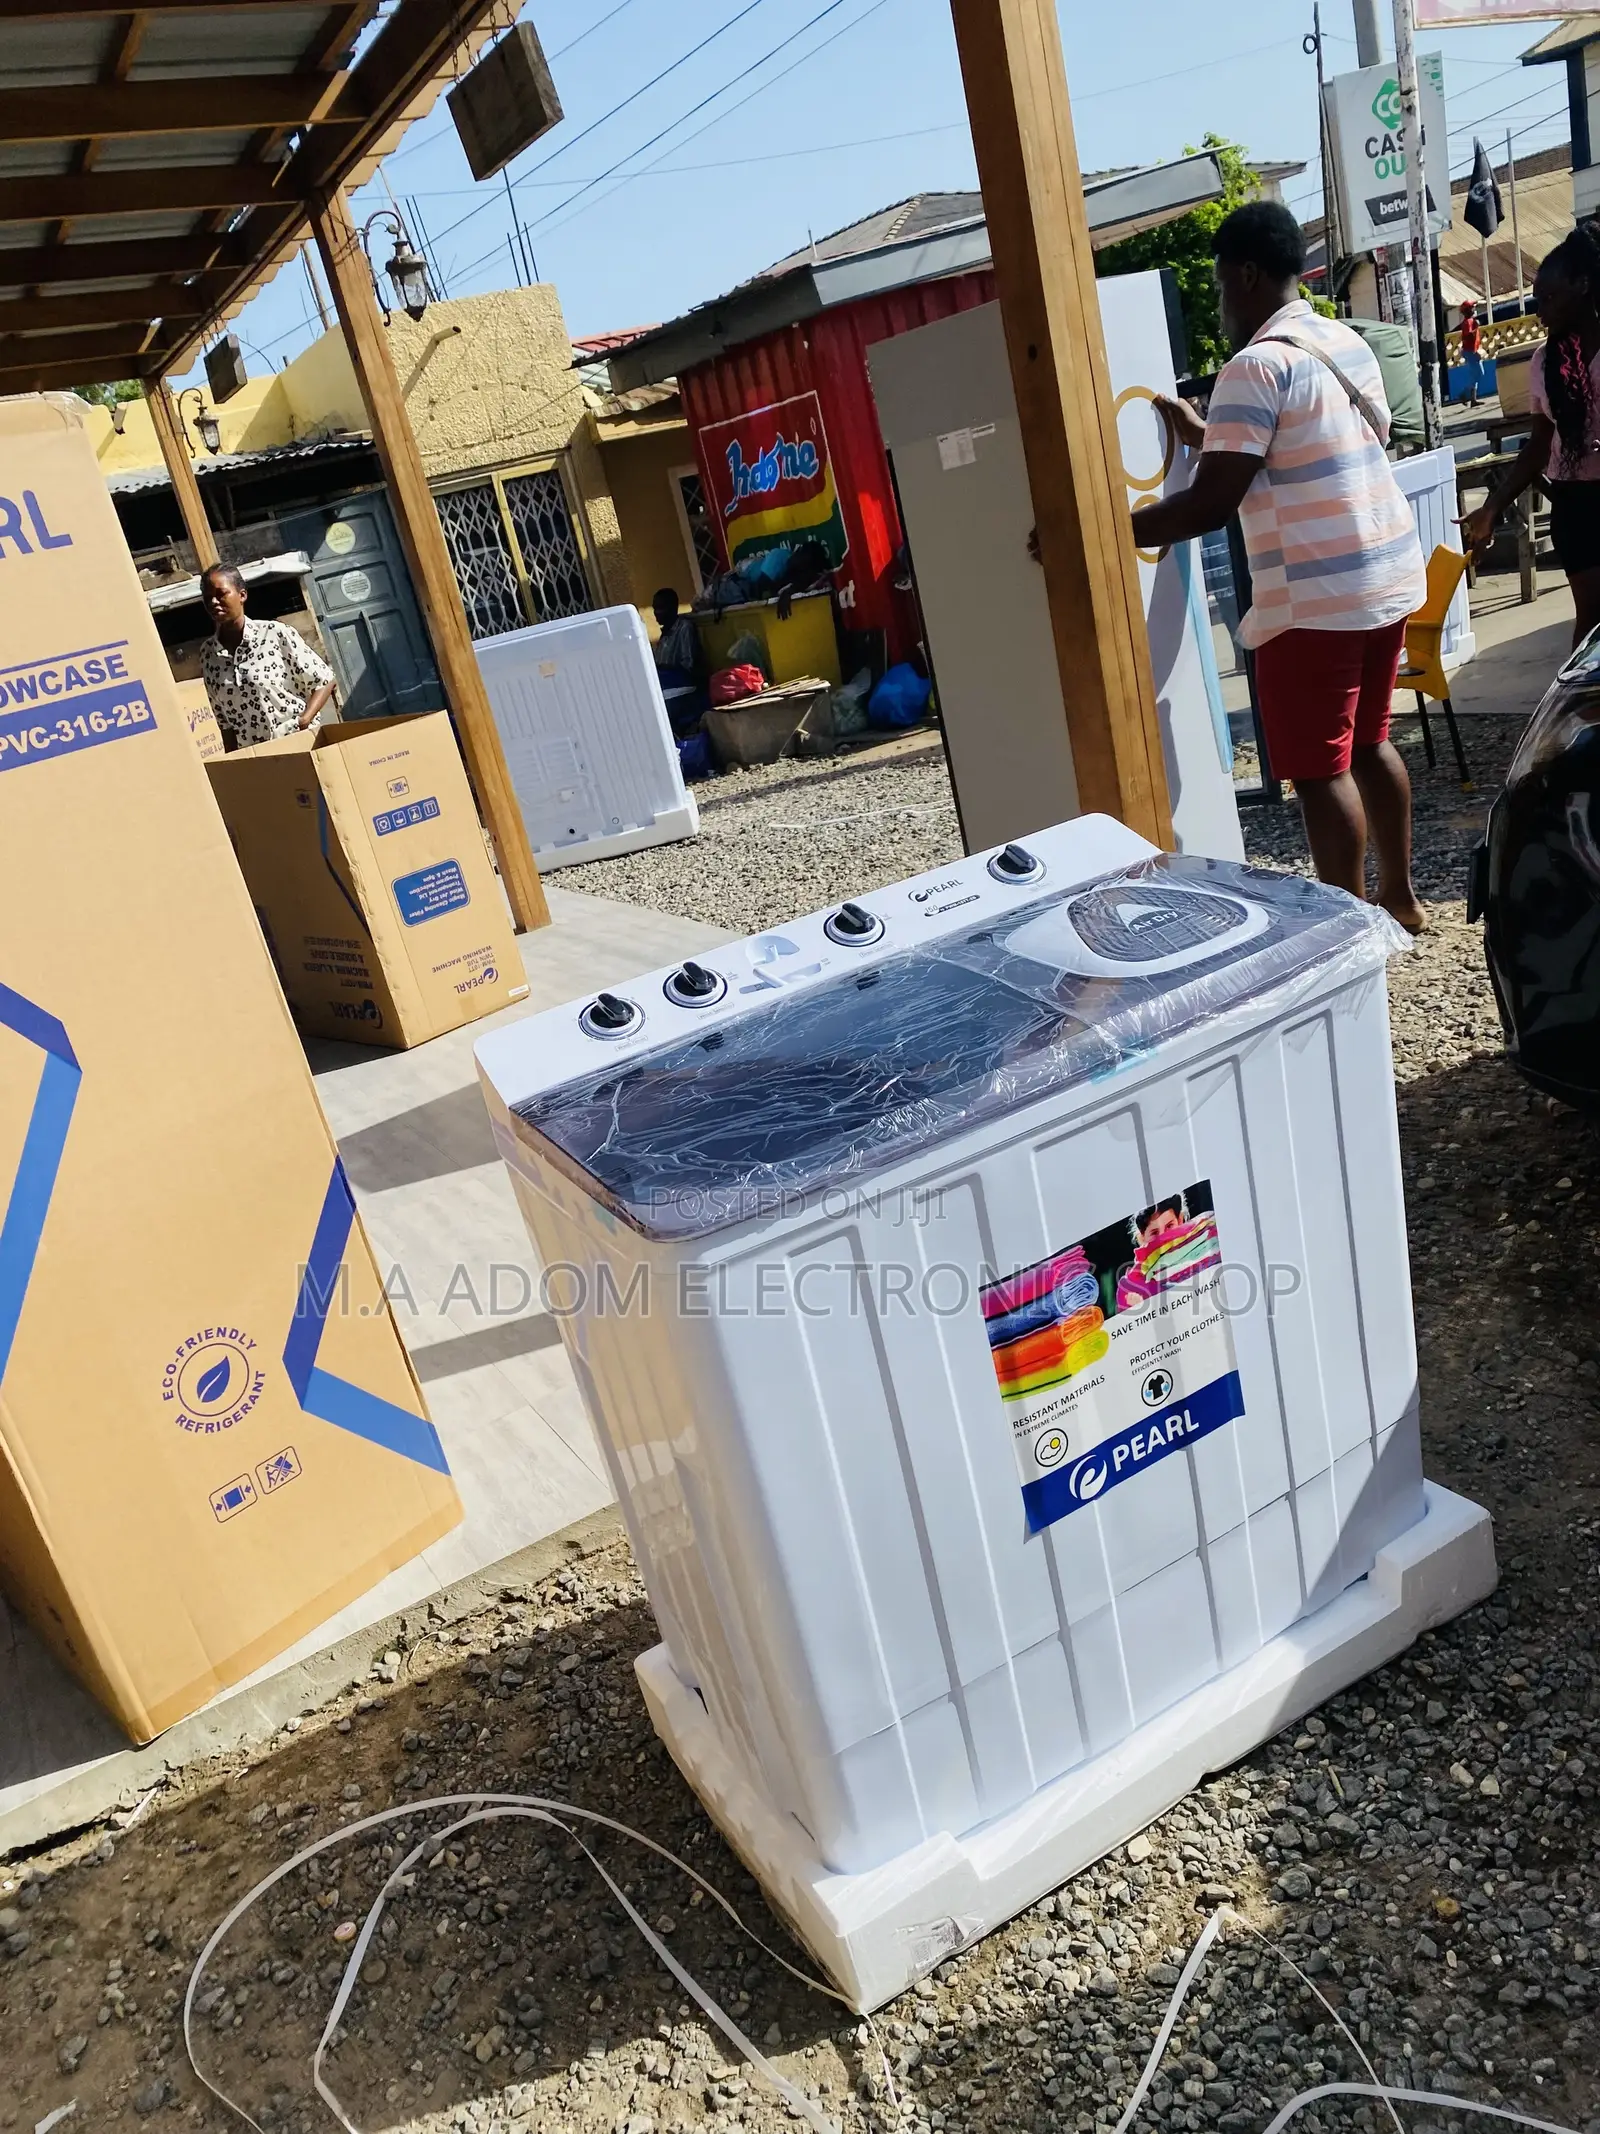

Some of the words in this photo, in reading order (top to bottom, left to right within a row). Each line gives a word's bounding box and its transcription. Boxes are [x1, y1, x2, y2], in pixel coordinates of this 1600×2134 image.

[1365, 124, 1426, 159] CAS
[1374, 154, 1408, 180] OU
[368, 757, 387, 767] CHINA
[925, 879, 964, 896] PEARL
[1132, 921, 1154, 931] Air
[1151, 911, 1179, 923] Dry
[431, 959, 462, 974] MACHINE
[461, 945, 493, 960] WASHING
[453, 974, 485, 994] PEARL
[1110, 1322, 1134, 1340] SAVE
[1134, 1309, 1157, 1327] TIME
[1158, 1305, 1169, 1316] IN
[1171, 1292, 1194, 1311] EACH
[1194, 1278, 1221, 1297] WASH
[1129, 1341, 1166, 1367] PROTECT
[1166, 1330, 1191, 1348] YOUR
[1191, 1311, 1225, 1335] CLOTHES
[162, 1326, 258, 1402] ECO-FRIENDLY
[1131, 1354, 1163, 1376] EFFICIENTLY
[1163, 1347, 1182, 1359] WASH
[174, 1370, 266, 1434] REFRIGERANT
[1012, 1400, 1059, 1430] RESISTANT
[1060, 1374, 1106, 1406] MATERIALS
[1023, 1417, 1050, 1436] EXTREME
[1051, 1403, 1079, 1421] CLIMATES
[1112, 1408, 1200, 1473] PEARL
